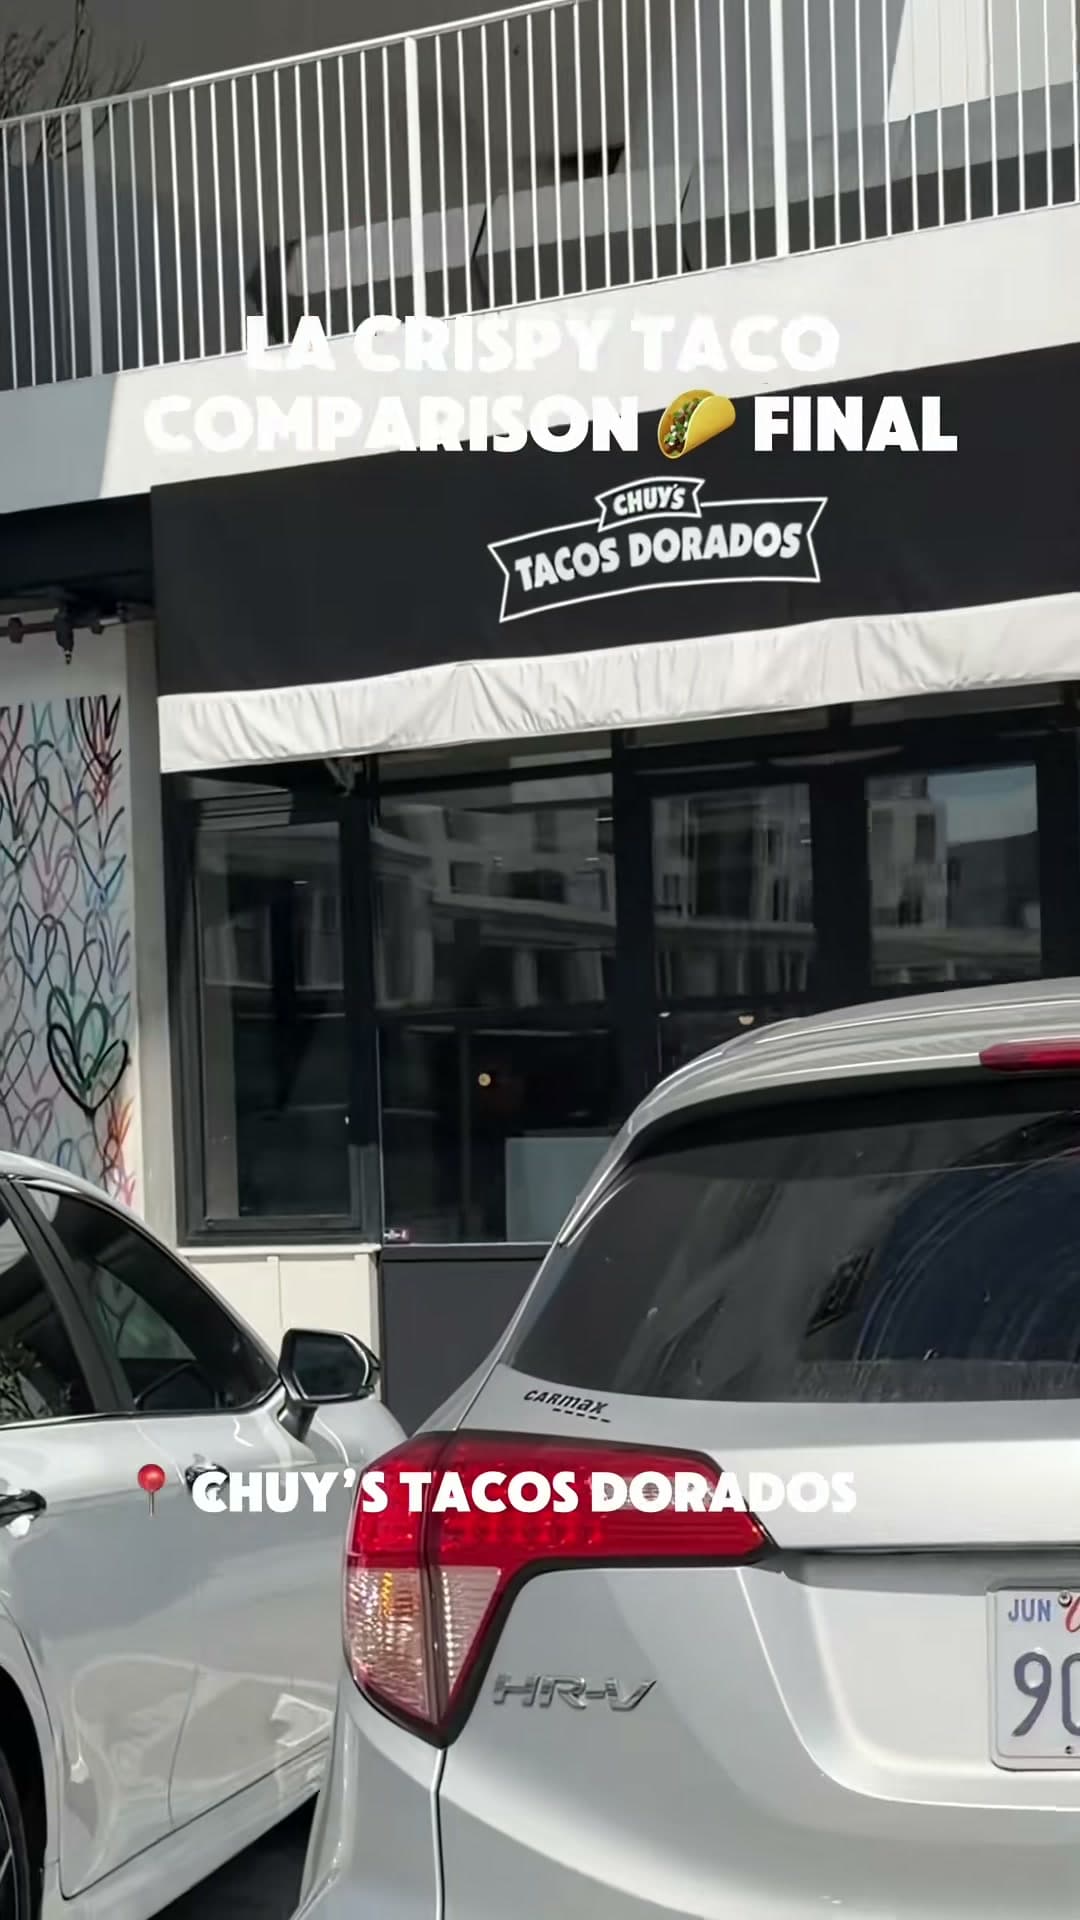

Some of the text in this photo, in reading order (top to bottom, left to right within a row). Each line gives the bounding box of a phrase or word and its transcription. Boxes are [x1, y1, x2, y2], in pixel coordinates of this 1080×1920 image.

[613, 484, 687, 517] CHUY'S
[514, 521, 802, 592] TACOS DORADOS
[1008, 1598, 1051, 1622] JUN
[493, 1673, 658, 1713] HR-V
